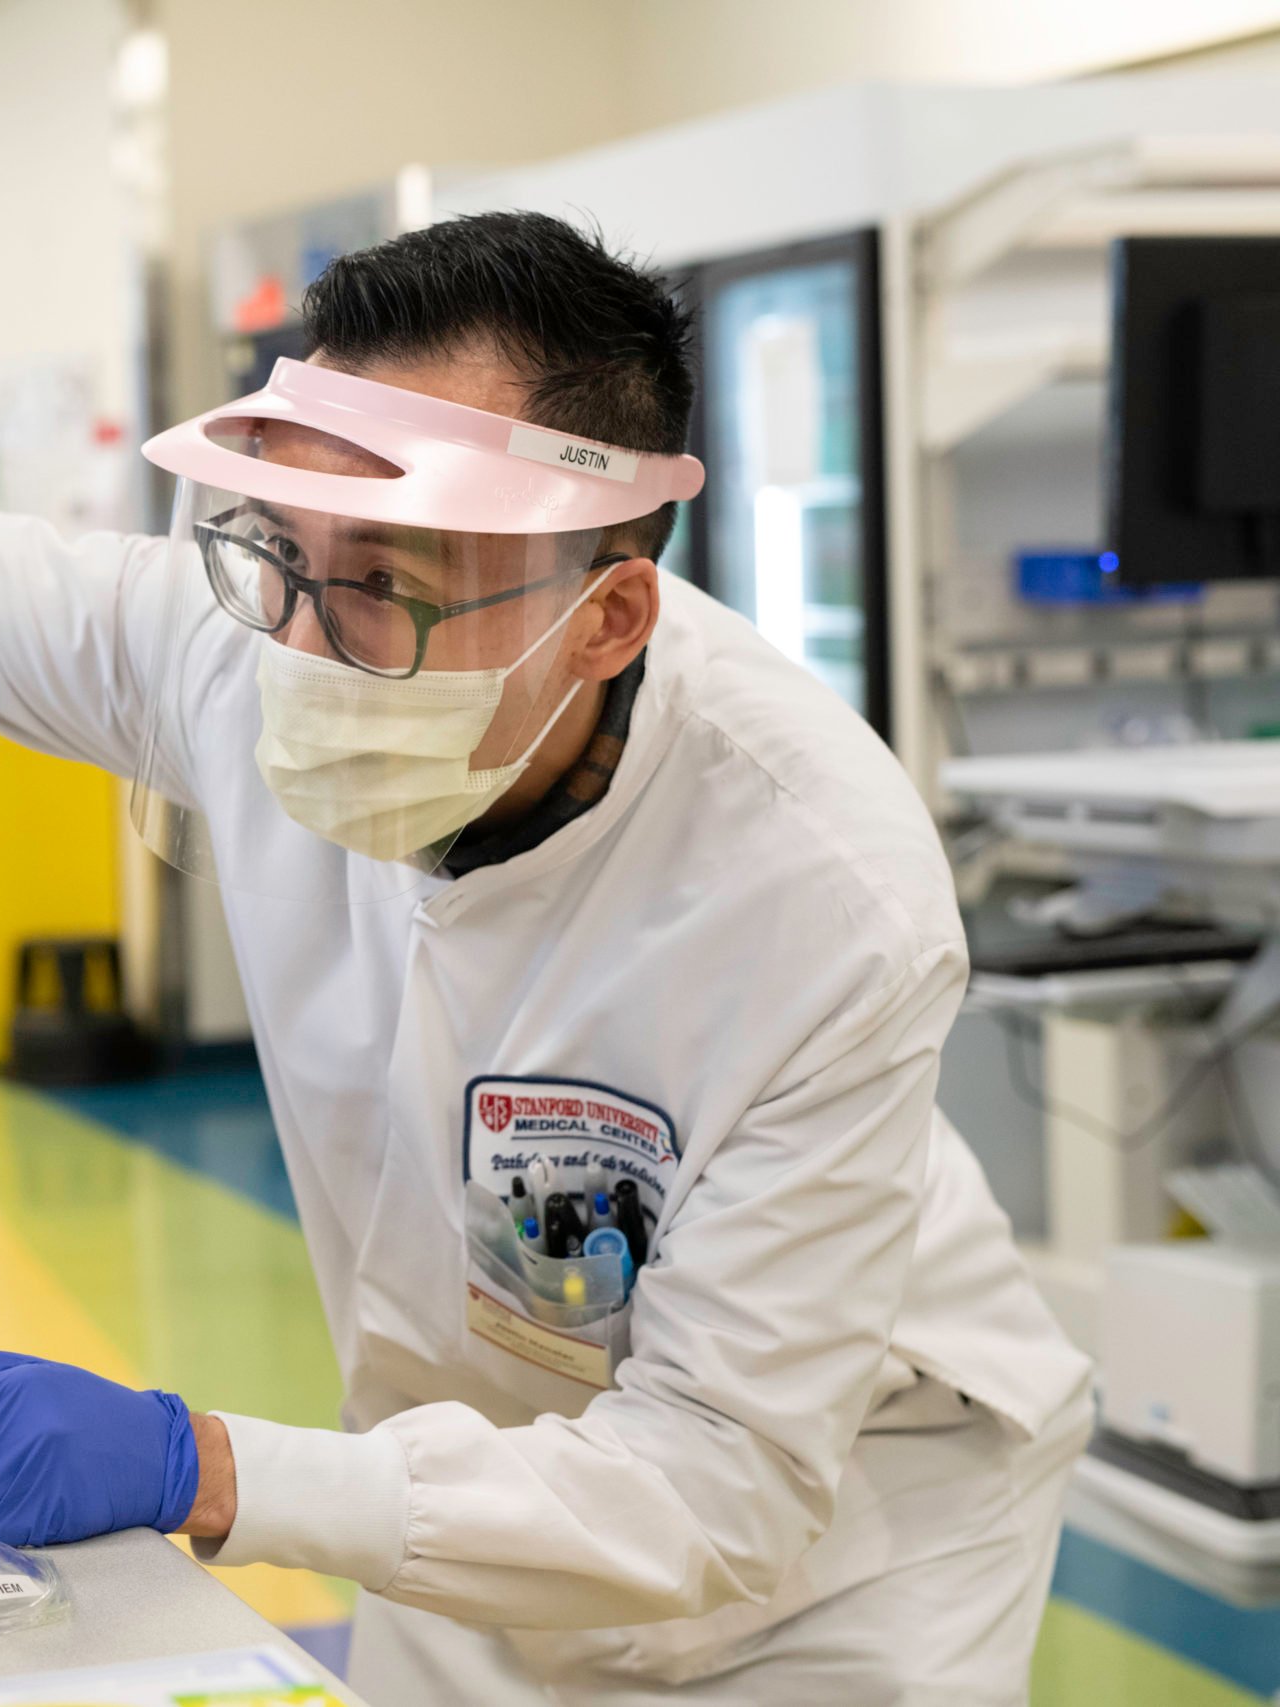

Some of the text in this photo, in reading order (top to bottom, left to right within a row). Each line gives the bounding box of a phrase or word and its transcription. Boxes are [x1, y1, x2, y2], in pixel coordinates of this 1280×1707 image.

[559, 445, 610, 471] JUSTIN
[512, 1097, 660, 1142] STANFORD UNIVERSITY
[514, 1118, 659, 1158] MEDICAL CENTER
[491, 1151, 561, 1171] Patholy
[563, 1151, 590, 1168] and
